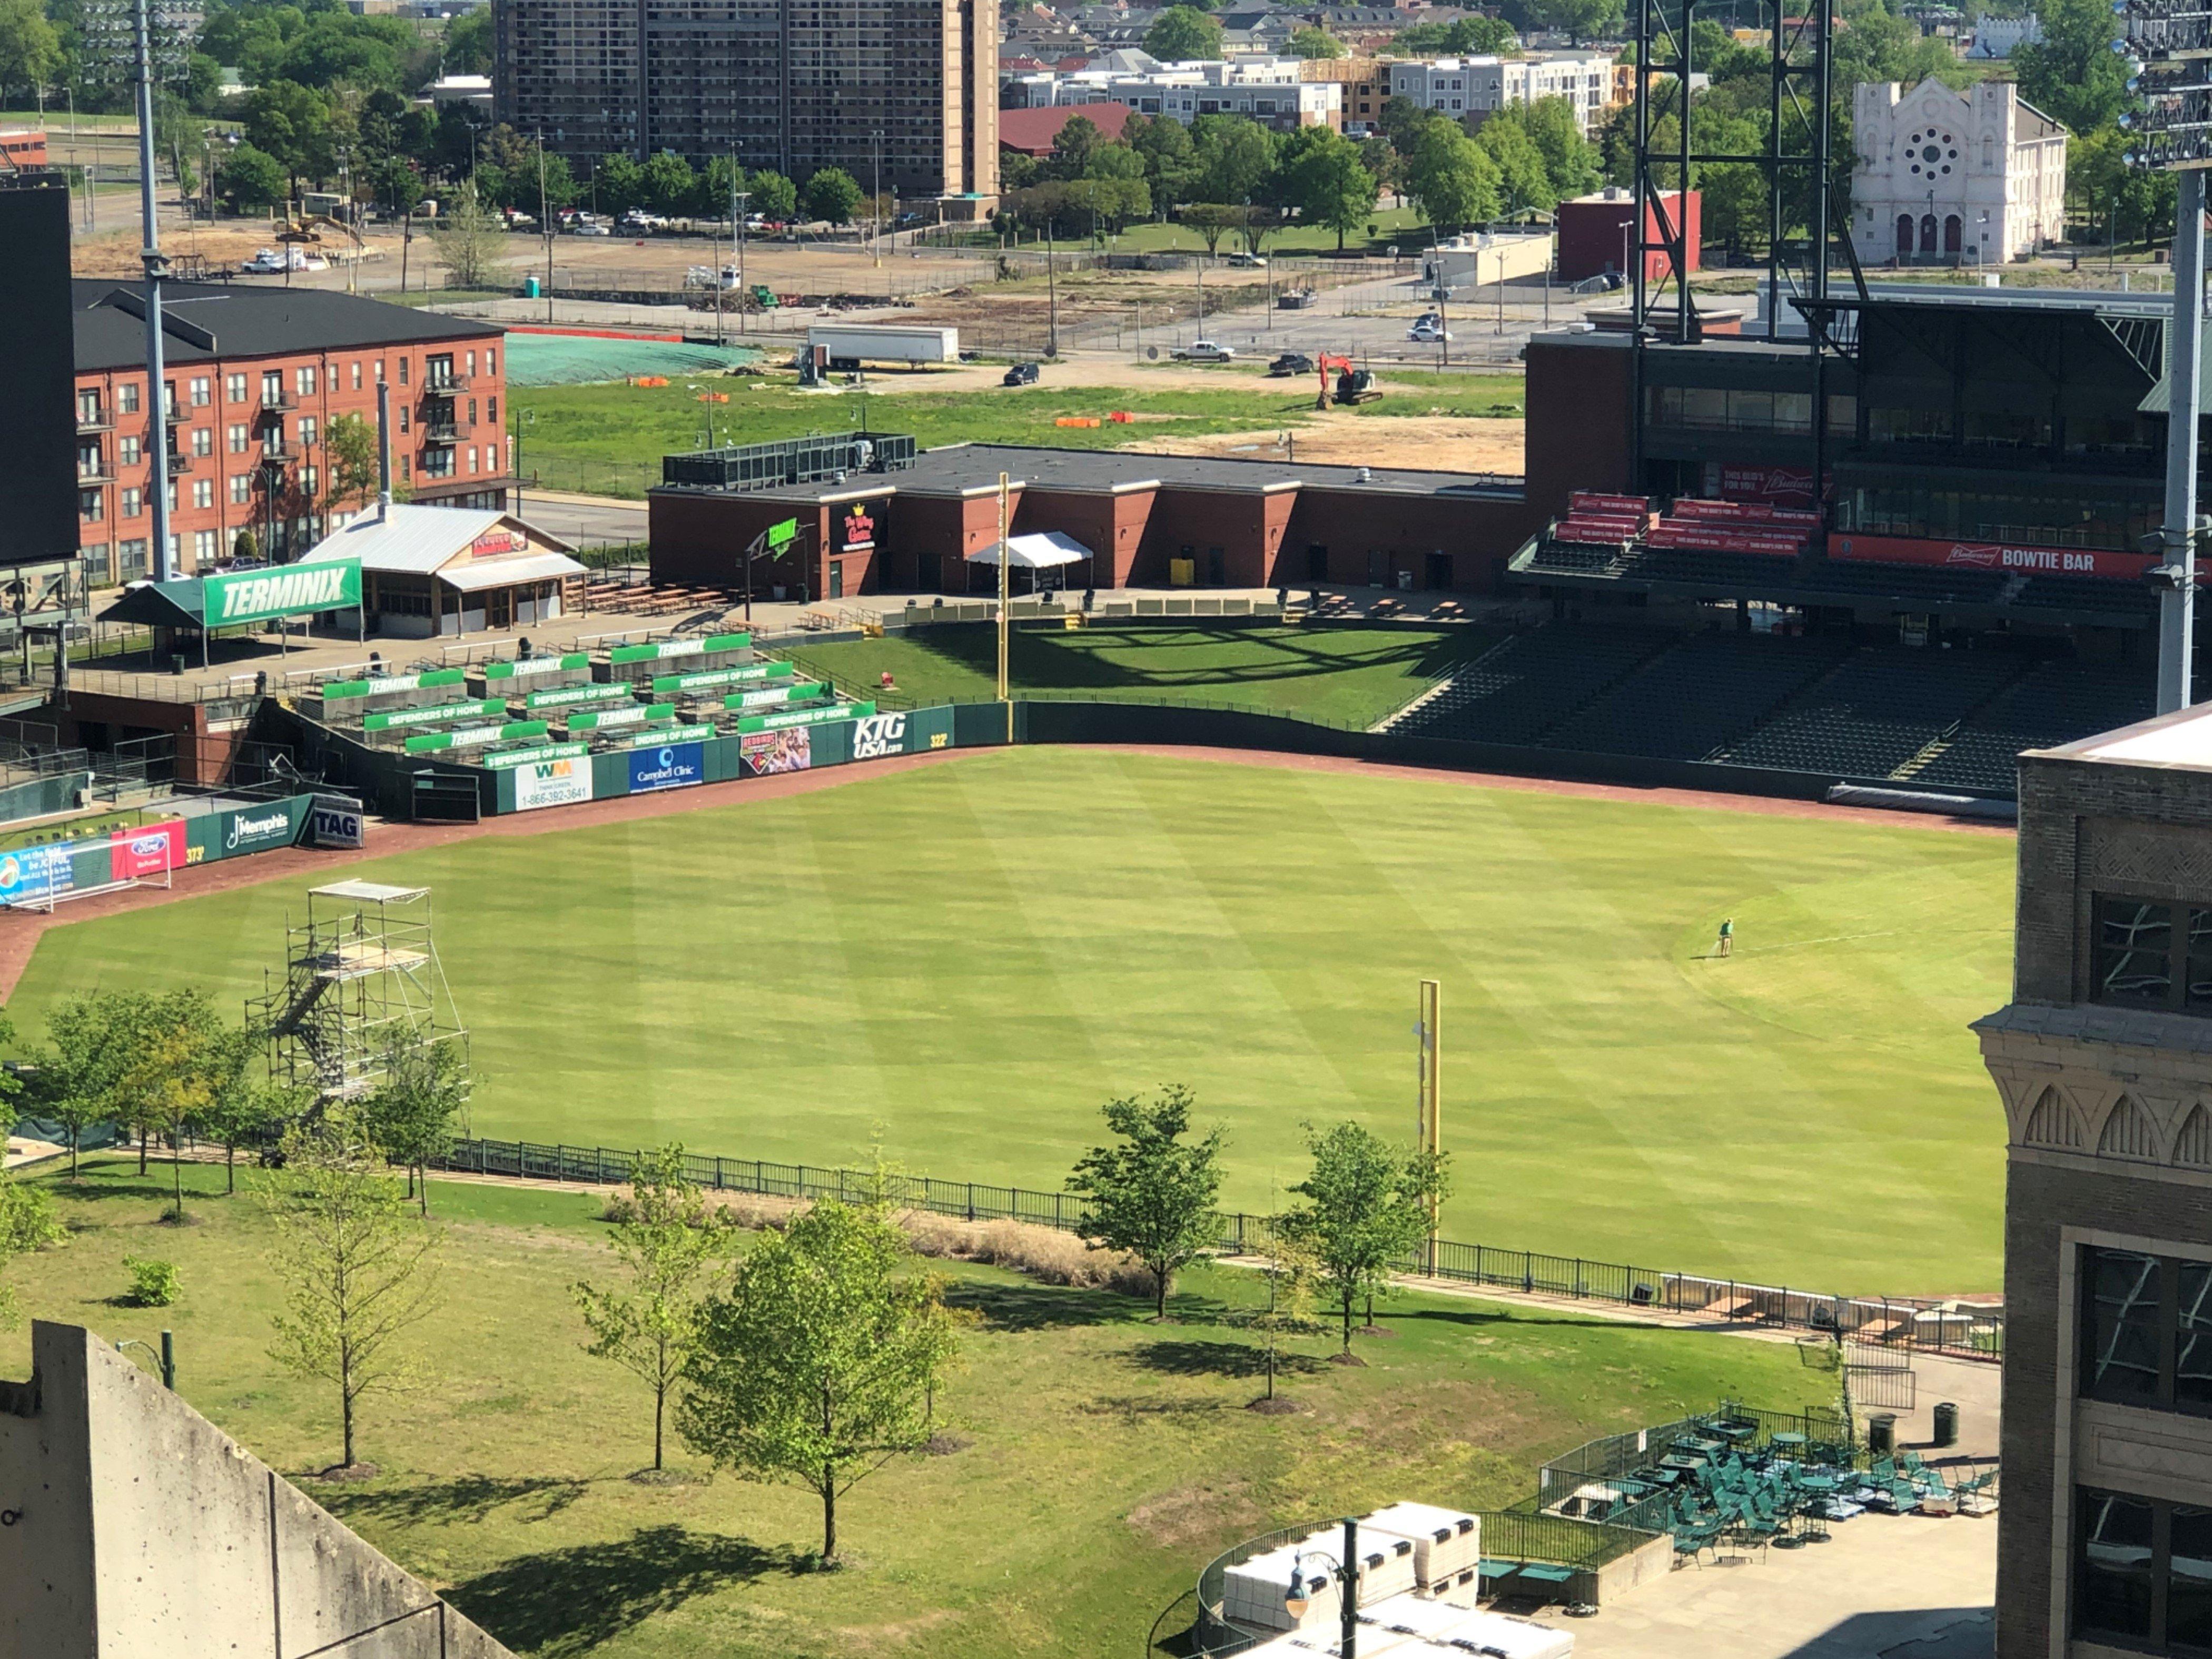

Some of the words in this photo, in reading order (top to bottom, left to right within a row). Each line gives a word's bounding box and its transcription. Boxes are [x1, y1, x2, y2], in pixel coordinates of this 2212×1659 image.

[2002, 550, 2059, 569] BOWTIE
[2063, 554, 2095, 571] BAR
[222, 567, 347, 617] TERMINIX
[659, 639, 704, 657] TERMINIX
[513, 658, 561, 676] TERMINIX
[369, 676, 419, 694] TERMINIX
[680, 674, 728, 687] DEFENDERS
[730, 671, 741, 680] OF
[743, 669, 766, 679] HOME
[535, 691, 585, 705] DEFENDERS
[587, 689, 598, 698] OF
[599, 686, 625, 697] HOME
[743, 688, 789, 707] TERMINIX
[388, 709, 441, 725] DEFENDERS
[442, 708, 456, 717] OF
[457, 705, 483, 716] HOME
[597, 708, 647, 727] TERMINIX
[764, 713, 813, 727] DEFENDERS
[814, 711, 825, 720] OF
[826, 708, 851, 718] HOME
[451, 728, 501, 746] TERMINIX
[669, 732, 680, 740] OF
[682, 727, 708, 739] HOME
[854, 713, 906, 744] KTG
[542, 748, 554, 757] OF
[556, 745, 582, 756] HOME
[854, 739, 903, 759] USA.com
[535, 760, 572, 778] WM
[637, 767, 672, 784] Campbell
[674, 765, 694, 776] Clinic
[521, 787, 586, 806] 1-866-392-3641
[240, 813, 288, 836] Memphis
[315, 813, 357, 837] TAG
[137, 838, 160, 854] Ford
[186, 846, 204, 863] 373'
[29, 861, 38, 870] be
